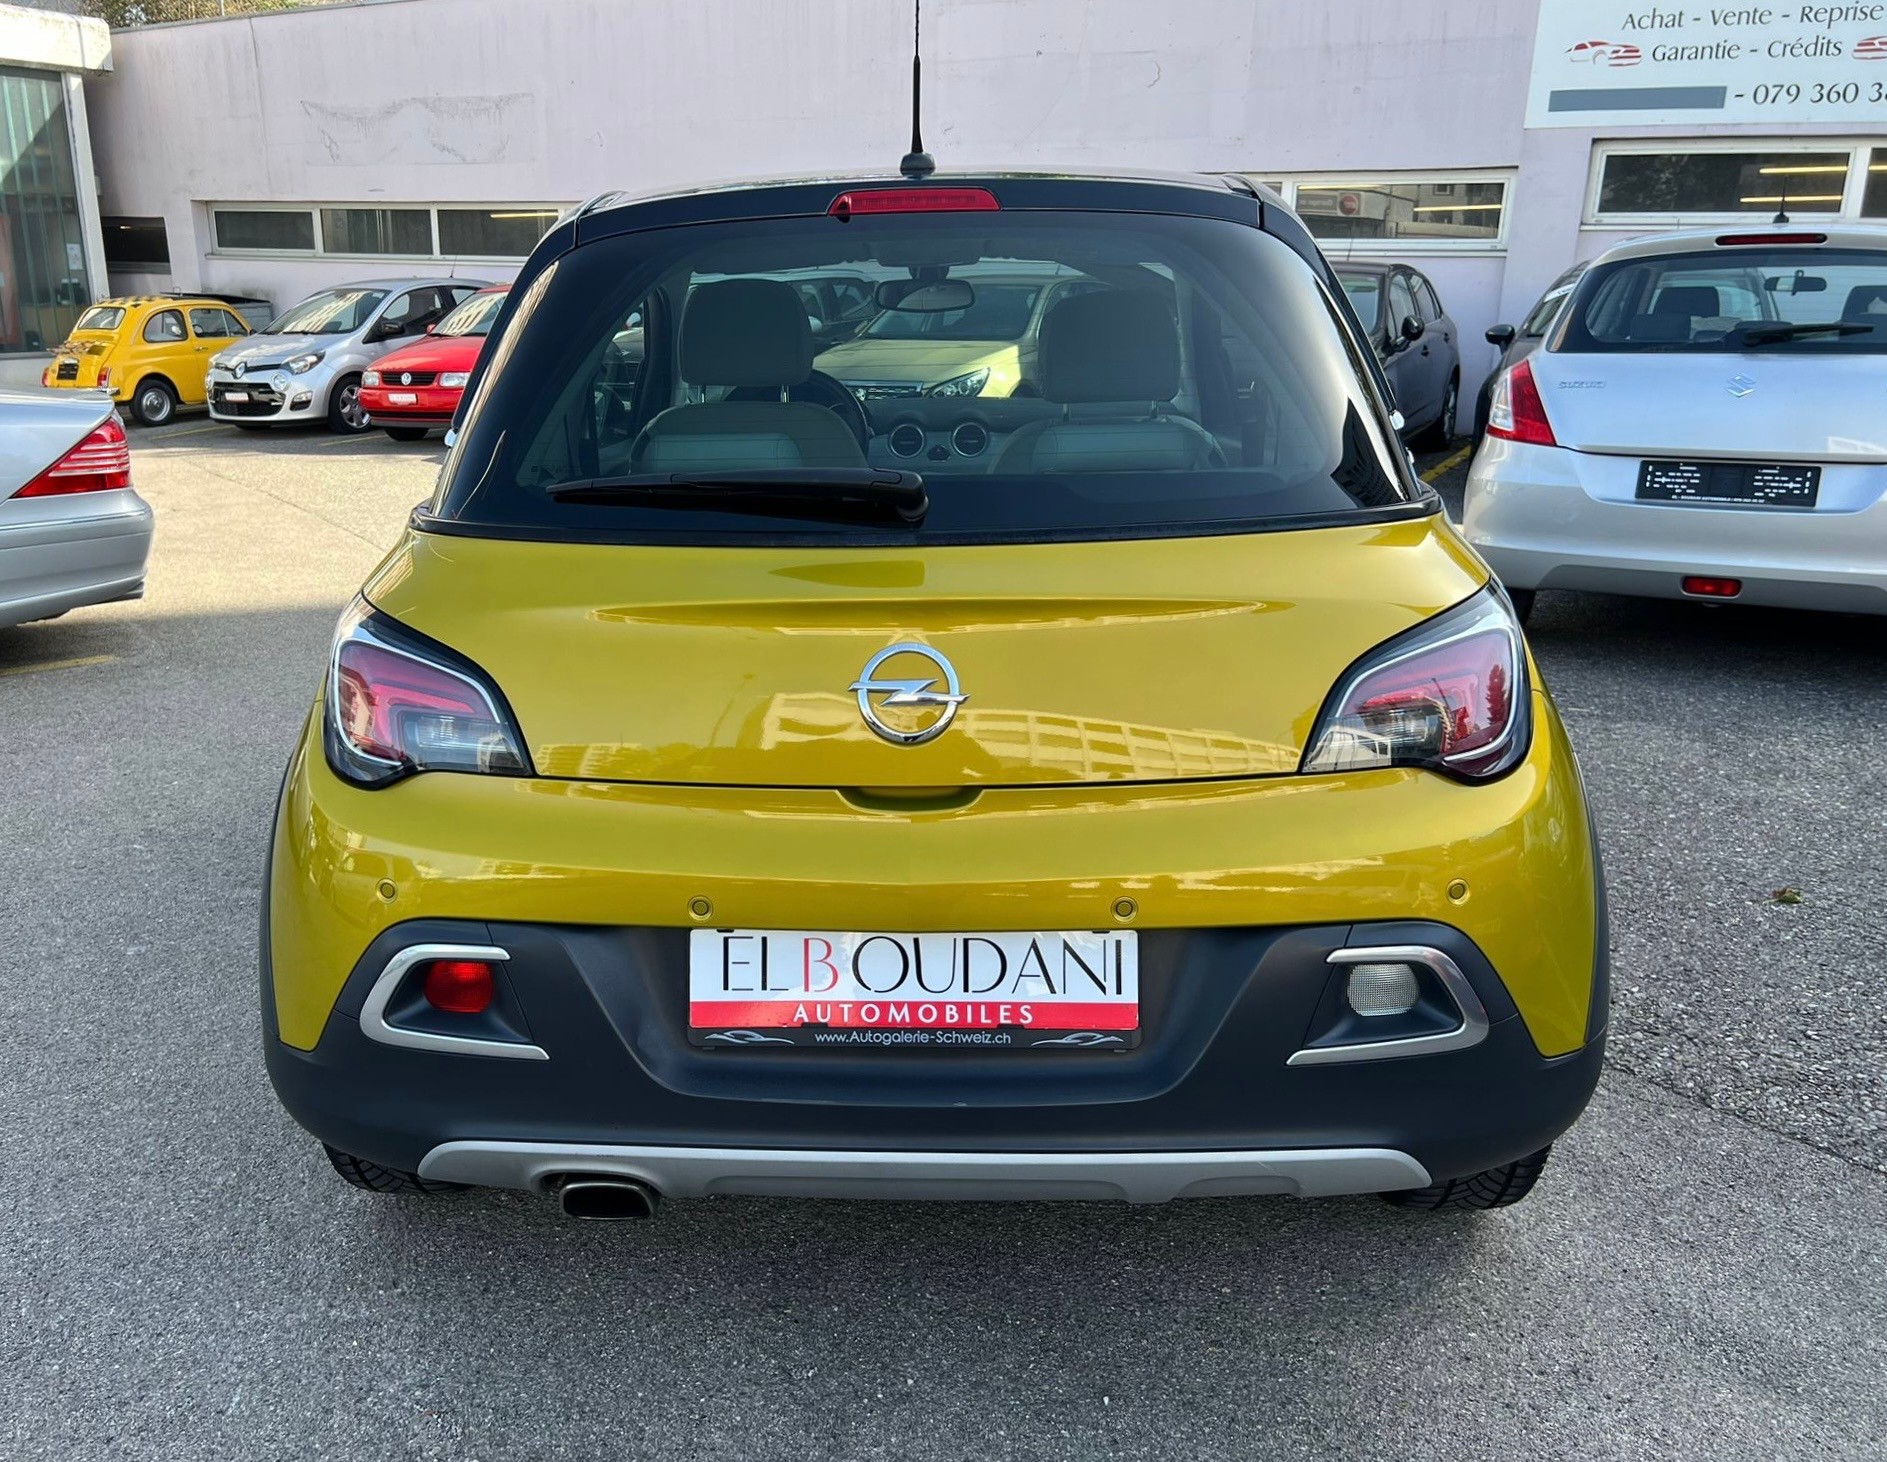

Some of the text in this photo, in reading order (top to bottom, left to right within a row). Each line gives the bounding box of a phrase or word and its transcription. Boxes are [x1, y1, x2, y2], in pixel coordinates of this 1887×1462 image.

[1622, 7, 1684, 30] Achat
[1711, 7, 1772, 26] Vente
[1800, 1, 1884, 29] Reprise
[1652, 39, 1741, 61] Garantie
[1767, 35, 1843, 58] Crédits
[1753, 83, 1800, 105] 079
[1810, 82, 1859, 103] 360
[1868, 82, 1887, 103] 3
[723, 936, 1122, 996] EL BOUDANI
[793, 1003, 1033, 1024] AUTOMOBILES
[815, 1030, 1011, 1045] www.Autogalerie-Schweiz.ch
